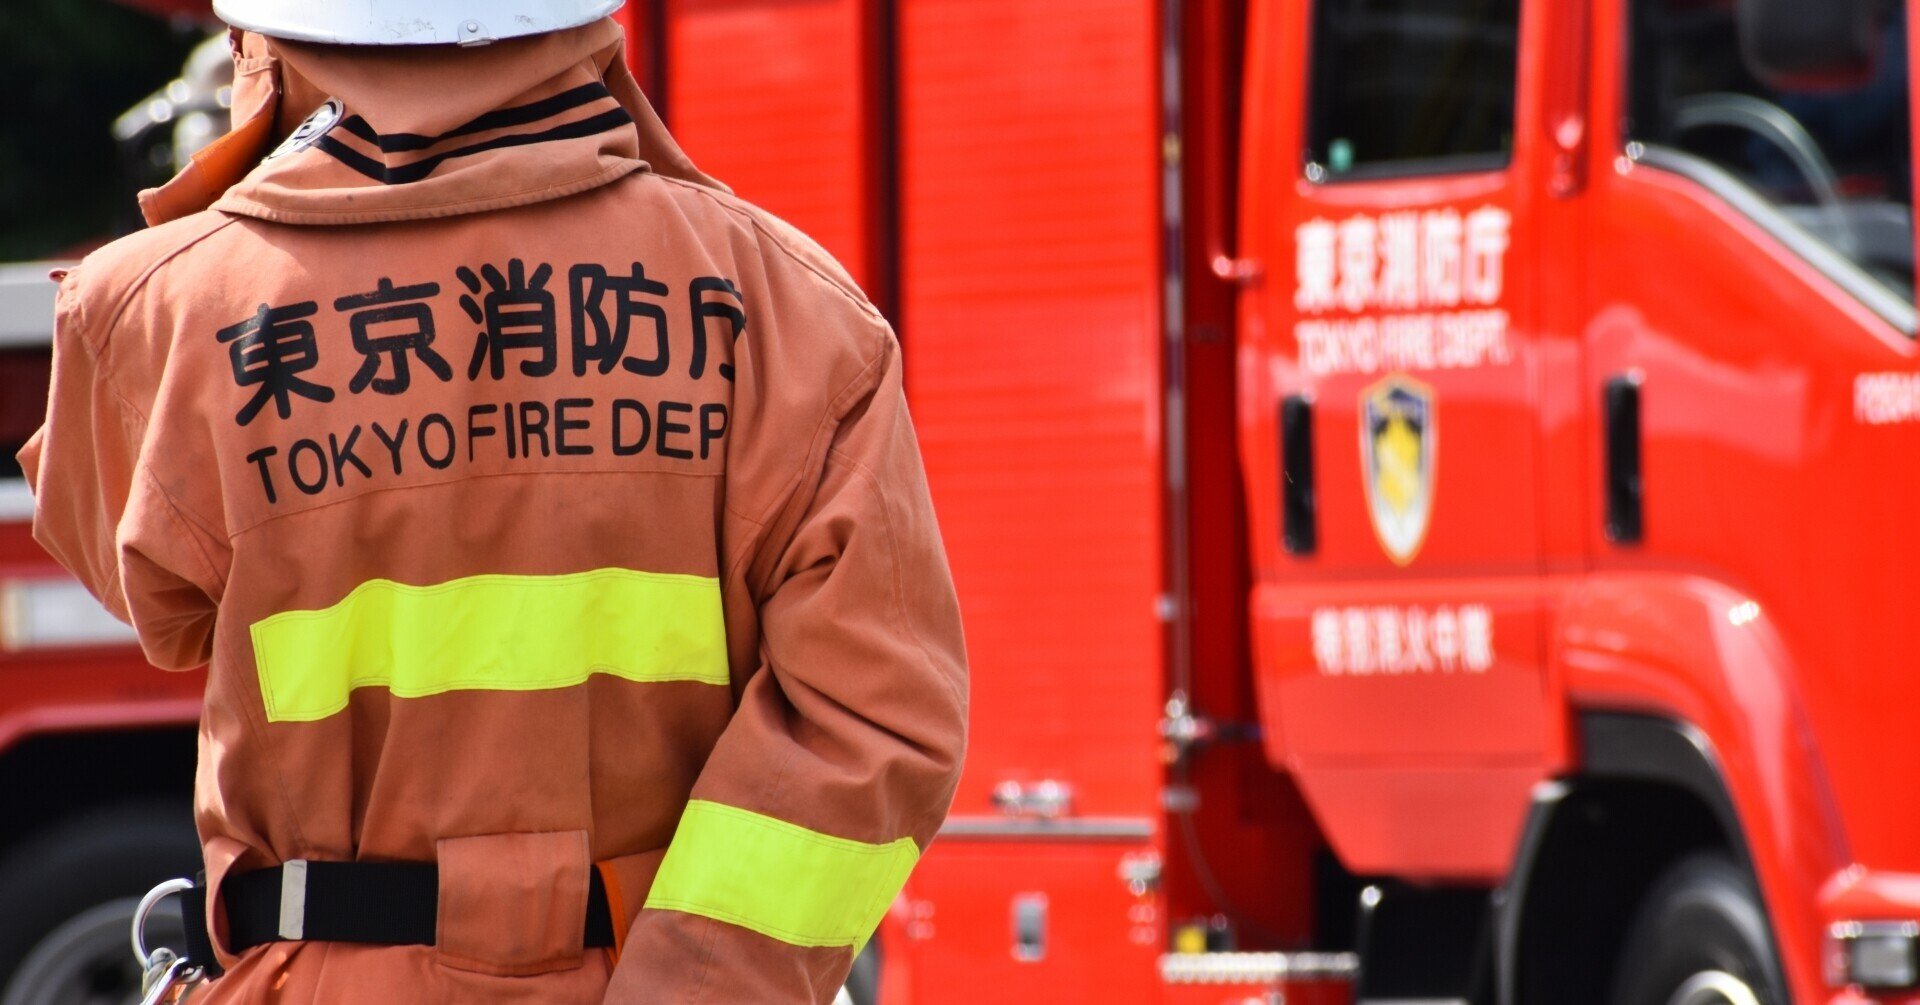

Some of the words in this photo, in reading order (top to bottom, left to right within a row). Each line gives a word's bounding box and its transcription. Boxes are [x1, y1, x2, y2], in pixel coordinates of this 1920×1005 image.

[1296, 205, 1511, 312] 東京消防庁
[1295, 317, 1378, 374] TOKYO
[1381, 313, 1436, 370] FIRE
[246, 414, 456, 504] TOKYO
[467, 398, 594, 462] FIRE
